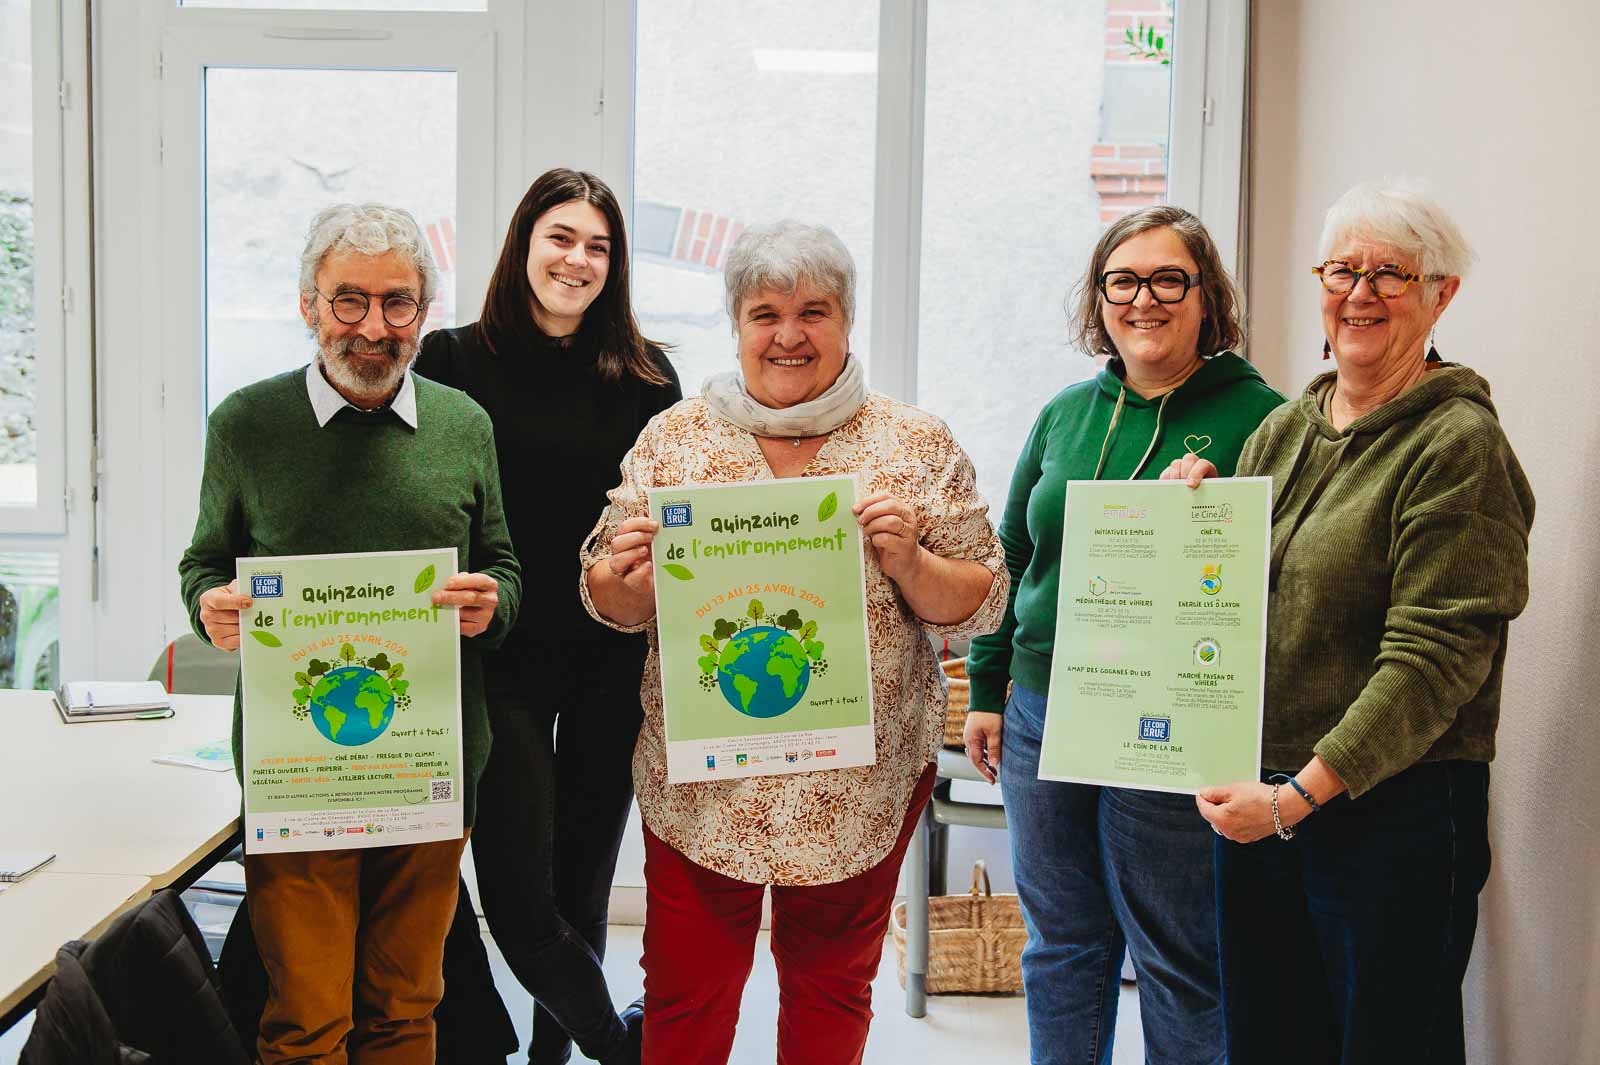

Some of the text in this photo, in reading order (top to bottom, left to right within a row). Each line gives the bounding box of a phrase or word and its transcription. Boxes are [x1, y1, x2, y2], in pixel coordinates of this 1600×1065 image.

[672, 514, 687, 524] RUE
[711, 512, 800, 534] Quinzaine
[1192, 511, 1200, 519] Le
[1202, 510, 1218, 519] Ciné
[667, 528, 847, 560] de l'environnement
[262, 586, 278, 594] RUE
[302, 583, 395, 603] Quinzaine
[696, 584, 826, 618] DU 13 AU 25 AVRIL 2026
[254, 604, 442, 628] de l'environnement
[291, 648, 306, 662] DU
[320, 637, 335, 649] AU
[353, 633, 382, 645] AVRIL
[384, 640, 409, 656] 2026
[426, 728, 444, 736] tous
[1149, 728, 1165, 738] RUE
